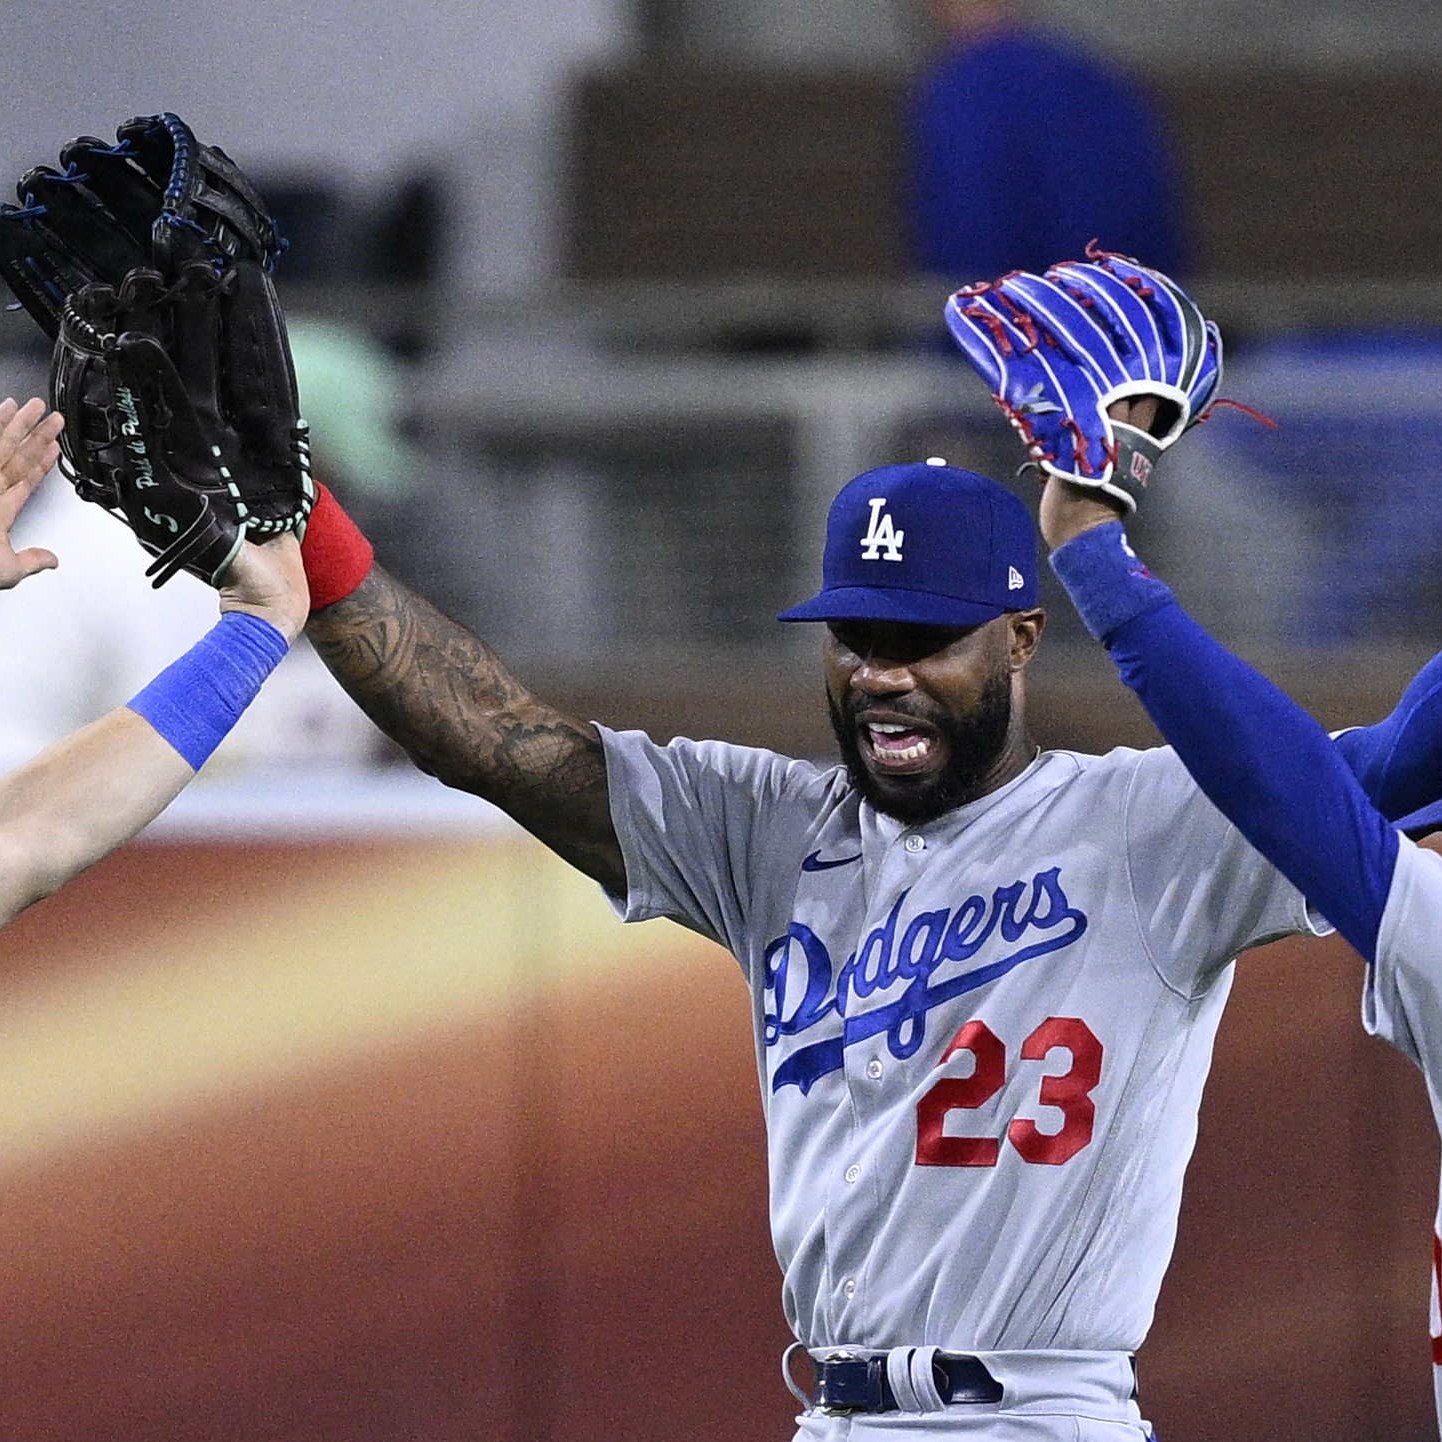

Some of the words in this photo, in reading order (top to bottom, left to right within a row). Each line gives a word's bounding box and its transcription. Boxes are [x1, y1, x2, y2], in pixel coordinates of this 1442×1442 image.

[860, 498, 905, 562] LA
[764, 866, 1088, 1061] Dodgers
[914, 1015, 1104, 1167] 23
